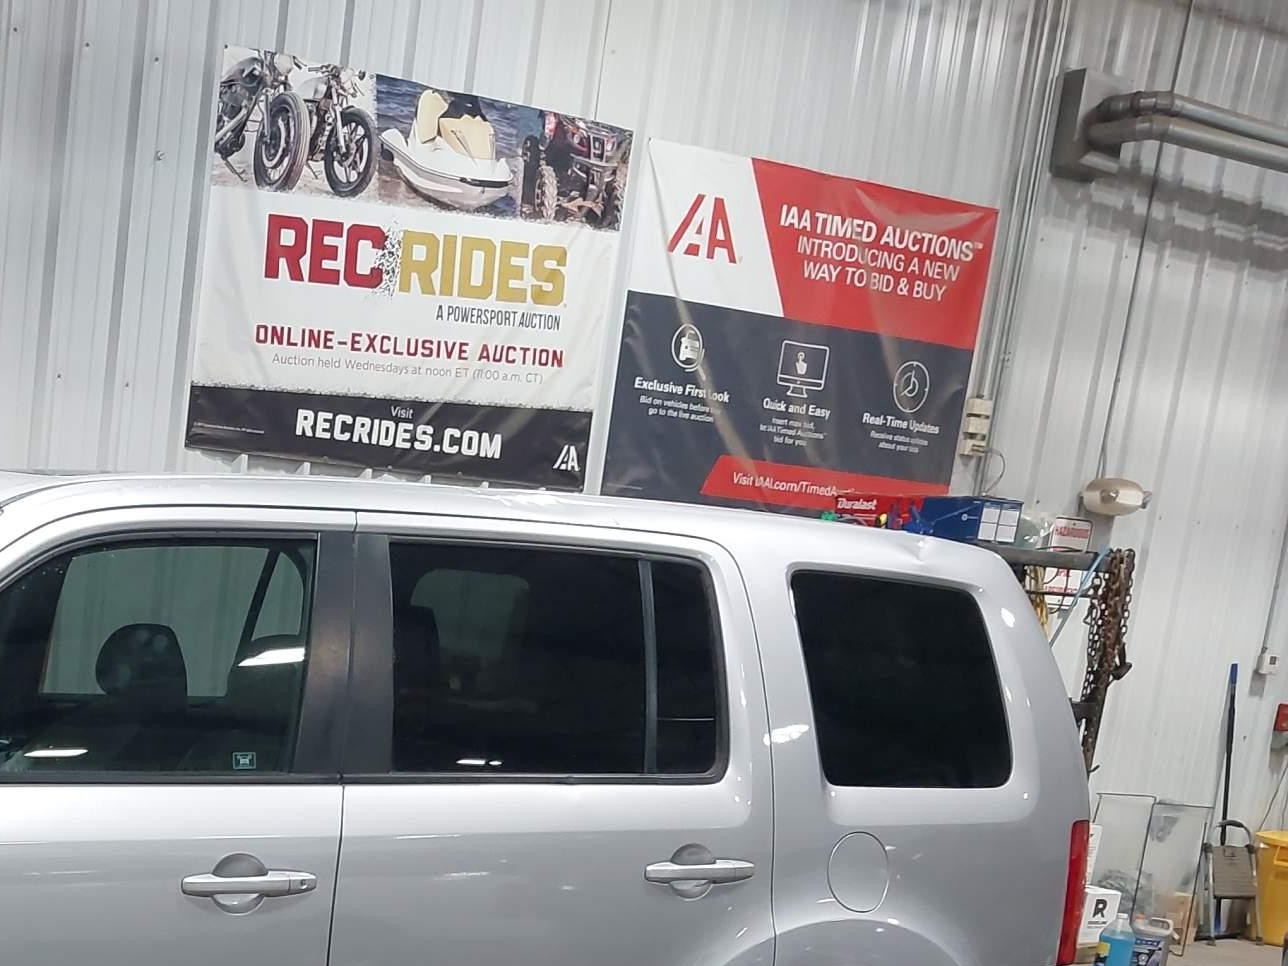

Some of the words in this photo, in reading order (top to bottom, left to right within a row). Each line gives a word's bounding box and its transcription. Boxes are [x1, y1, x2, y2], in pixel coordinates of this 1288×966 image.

[779, 204, 811, 232] IAA
[815, 212, 877, 243] TIMED
[797, 235, 905, 273] INTRODUCING
[907, 258, 919, 276] A
[922, 259, 960, 282] NEW
[803, 260, 842, 283] WAY
[845, 266, 867, 287] TO
[870, 272, 894, 293] BID
[897, 278, 909, 296] &
[912, 280, 947, 301] BUY
[436, 305, 444, 321] A
[447, 305, 517, 327] POWERSPORT
[519, 313, 561, 331] AUCTION
[255, 324, 469, 361] ONLINE-EXCLUSIVE
[477, 343, 564, 368] AUCTION
[272, 353, 315, 367] Auction
[317, 357, 341, 369] held
[345, 359, 409, 376] Wednesdays
[411, 365, 422, 376] at
[425, 367, 452, 377] noon
[455, 367, 469, 378] ET
[634, 376, 683, 394] Exclusive
[684, 384, 707, 399] First
[390, 405, 414, 419] Visit
[763, 397, 787, 412] Quick
[788, 404, 807, 415] and
[808, 404, 831, 420] Easy
[862, 412, 908, 429] Real-Time
[295, 408, 503, 460] RECRIDES.COM
[733, 471, 754, 486] Visit
[837, 497, 878, 511] Duralast
